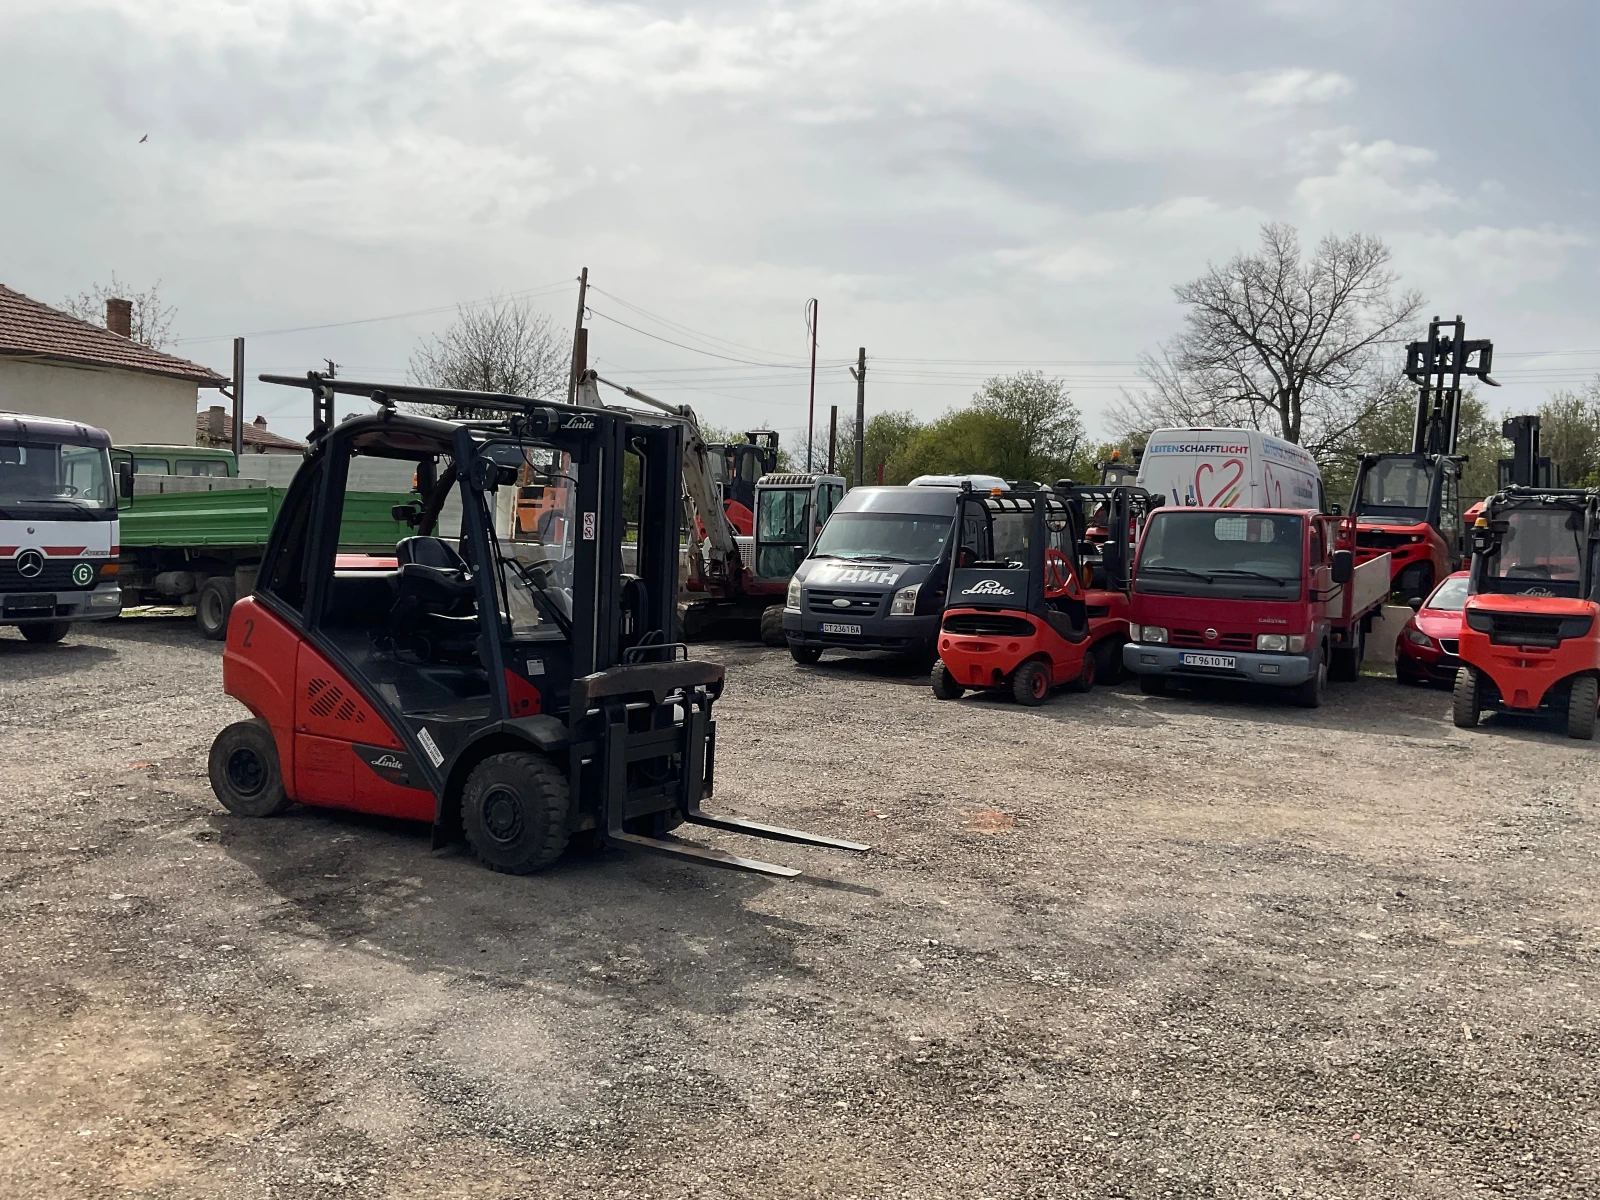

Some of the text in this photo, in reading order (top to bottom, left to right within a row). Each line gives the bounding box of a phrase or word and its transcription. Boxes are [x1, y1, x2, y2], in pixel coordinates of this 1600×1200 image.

[561, 416, 595, 429] Linde
[1150, 444, 1249, 455] LEITENSCHAFFTLICHT
[79, 568, 88, 581] G
[961, 579, 1015, 596] Linde
[1516, 586, 1556, 597] Linde
[243, 618, 254, 648] 2
[371, 754, 403, 769] Linde
